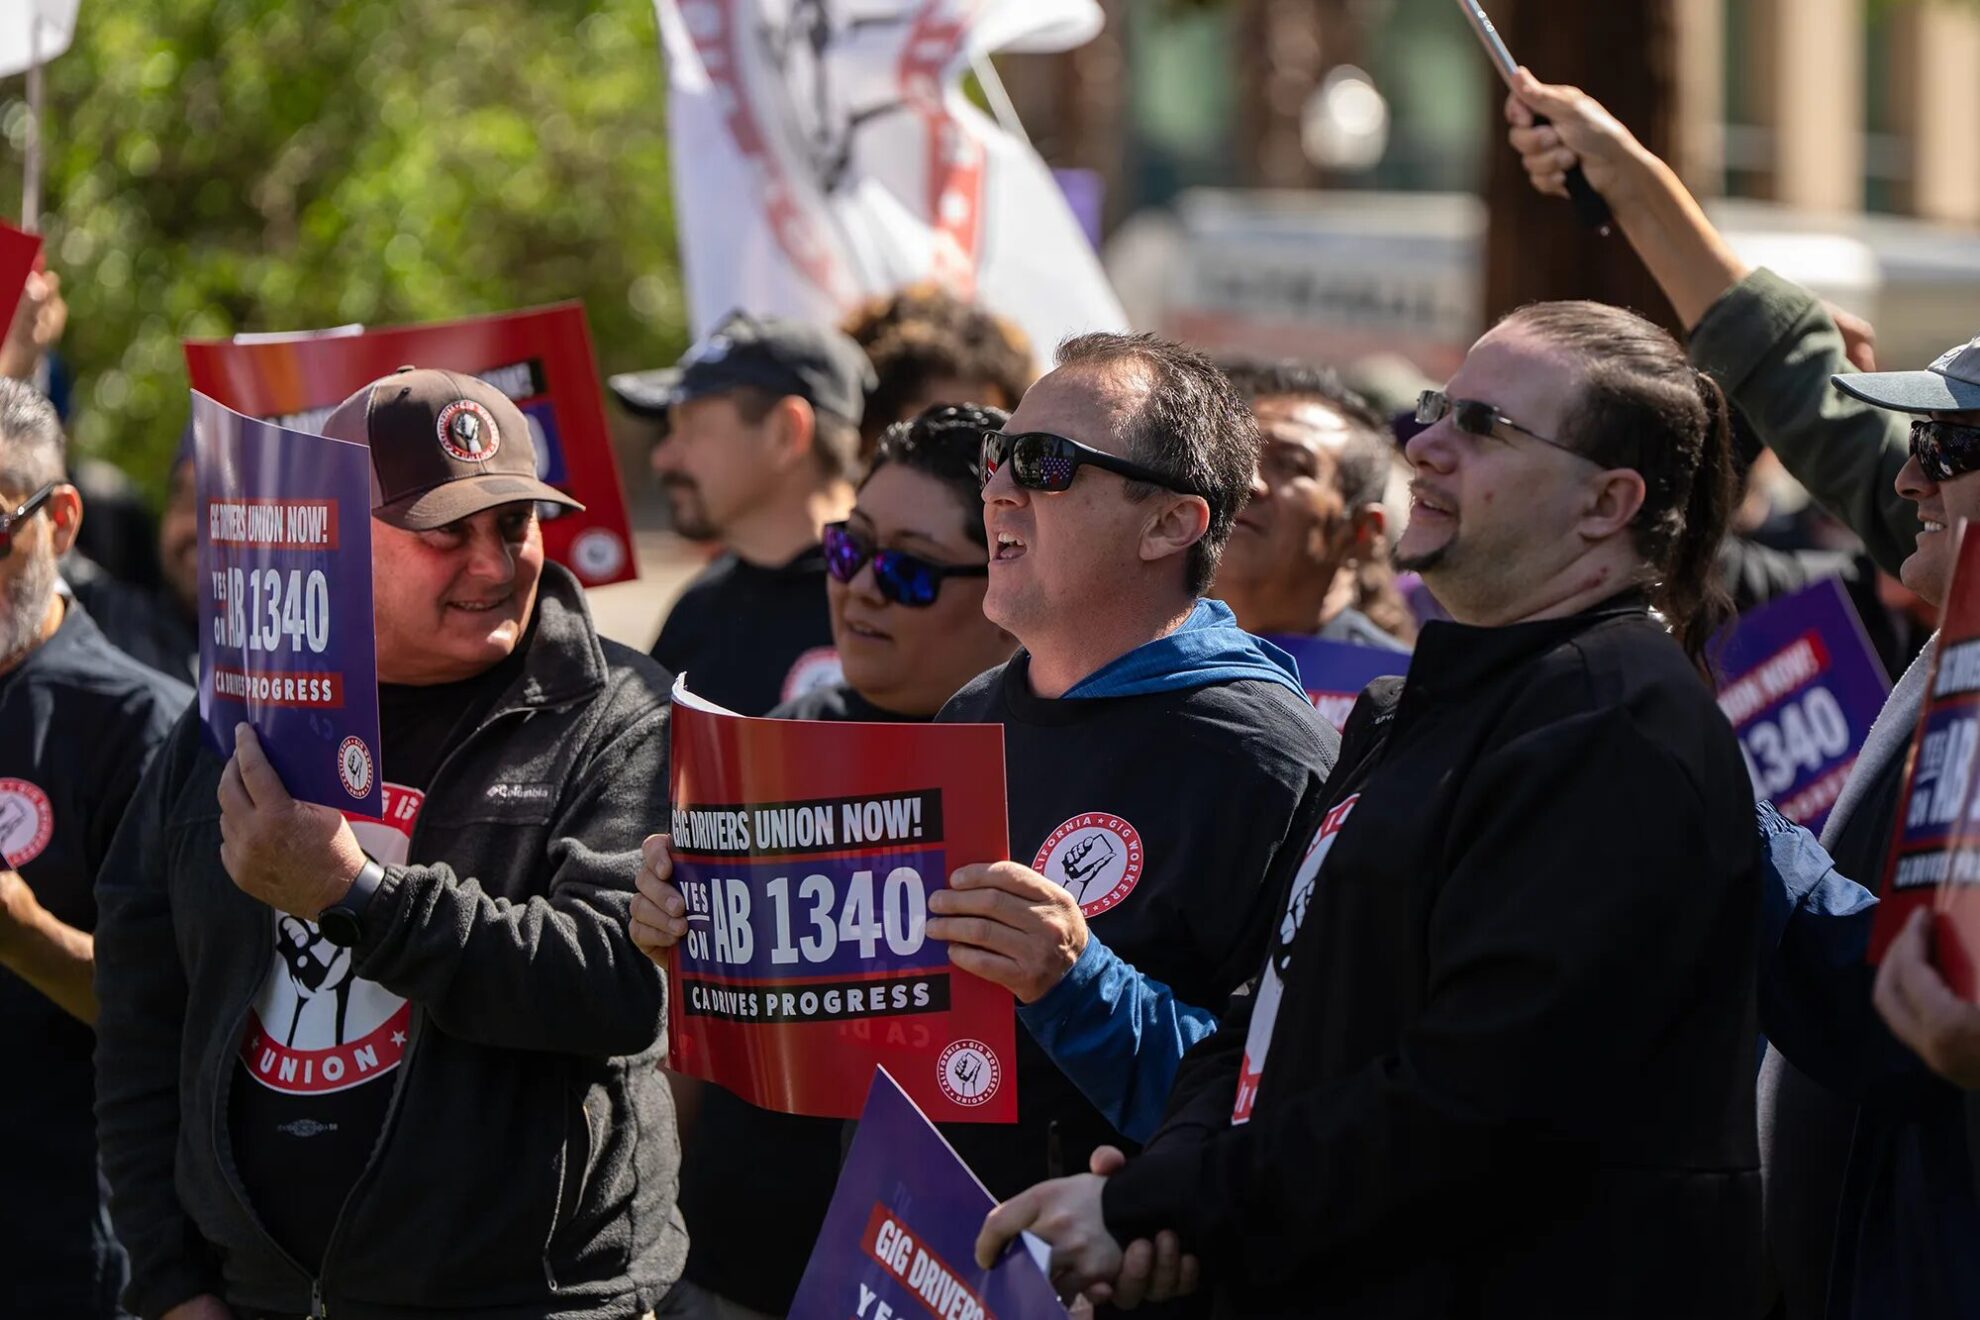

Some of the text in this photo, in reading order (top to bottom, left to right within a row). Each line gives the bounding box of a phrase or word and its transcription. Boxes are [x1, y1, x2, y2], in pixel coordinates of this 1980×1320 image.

[247, 505, 284, 543] UNION
[286, 505, 328, 544] NOW!
[212, 571, 226, 600] YES
[227, 567, 329, 653] AB 1340
[245, 676, 333, 702] PROGRESS
[671, 797, 923, 851] GIG DRIVERS UNION NOW!
[1035, 816, 1140, 907] LIFORNIA GIG WORKERS
[680, 880, 709, 914] YES
[711, 866, 927, 966] AB 1340
[687, 929, 710, 961] ON
[692, 982, 930, 1017] CA DRIVES PROGRESS
[259, 1044, 379, 1085] UNION
[875, 1219, 913, 1277] GIG
